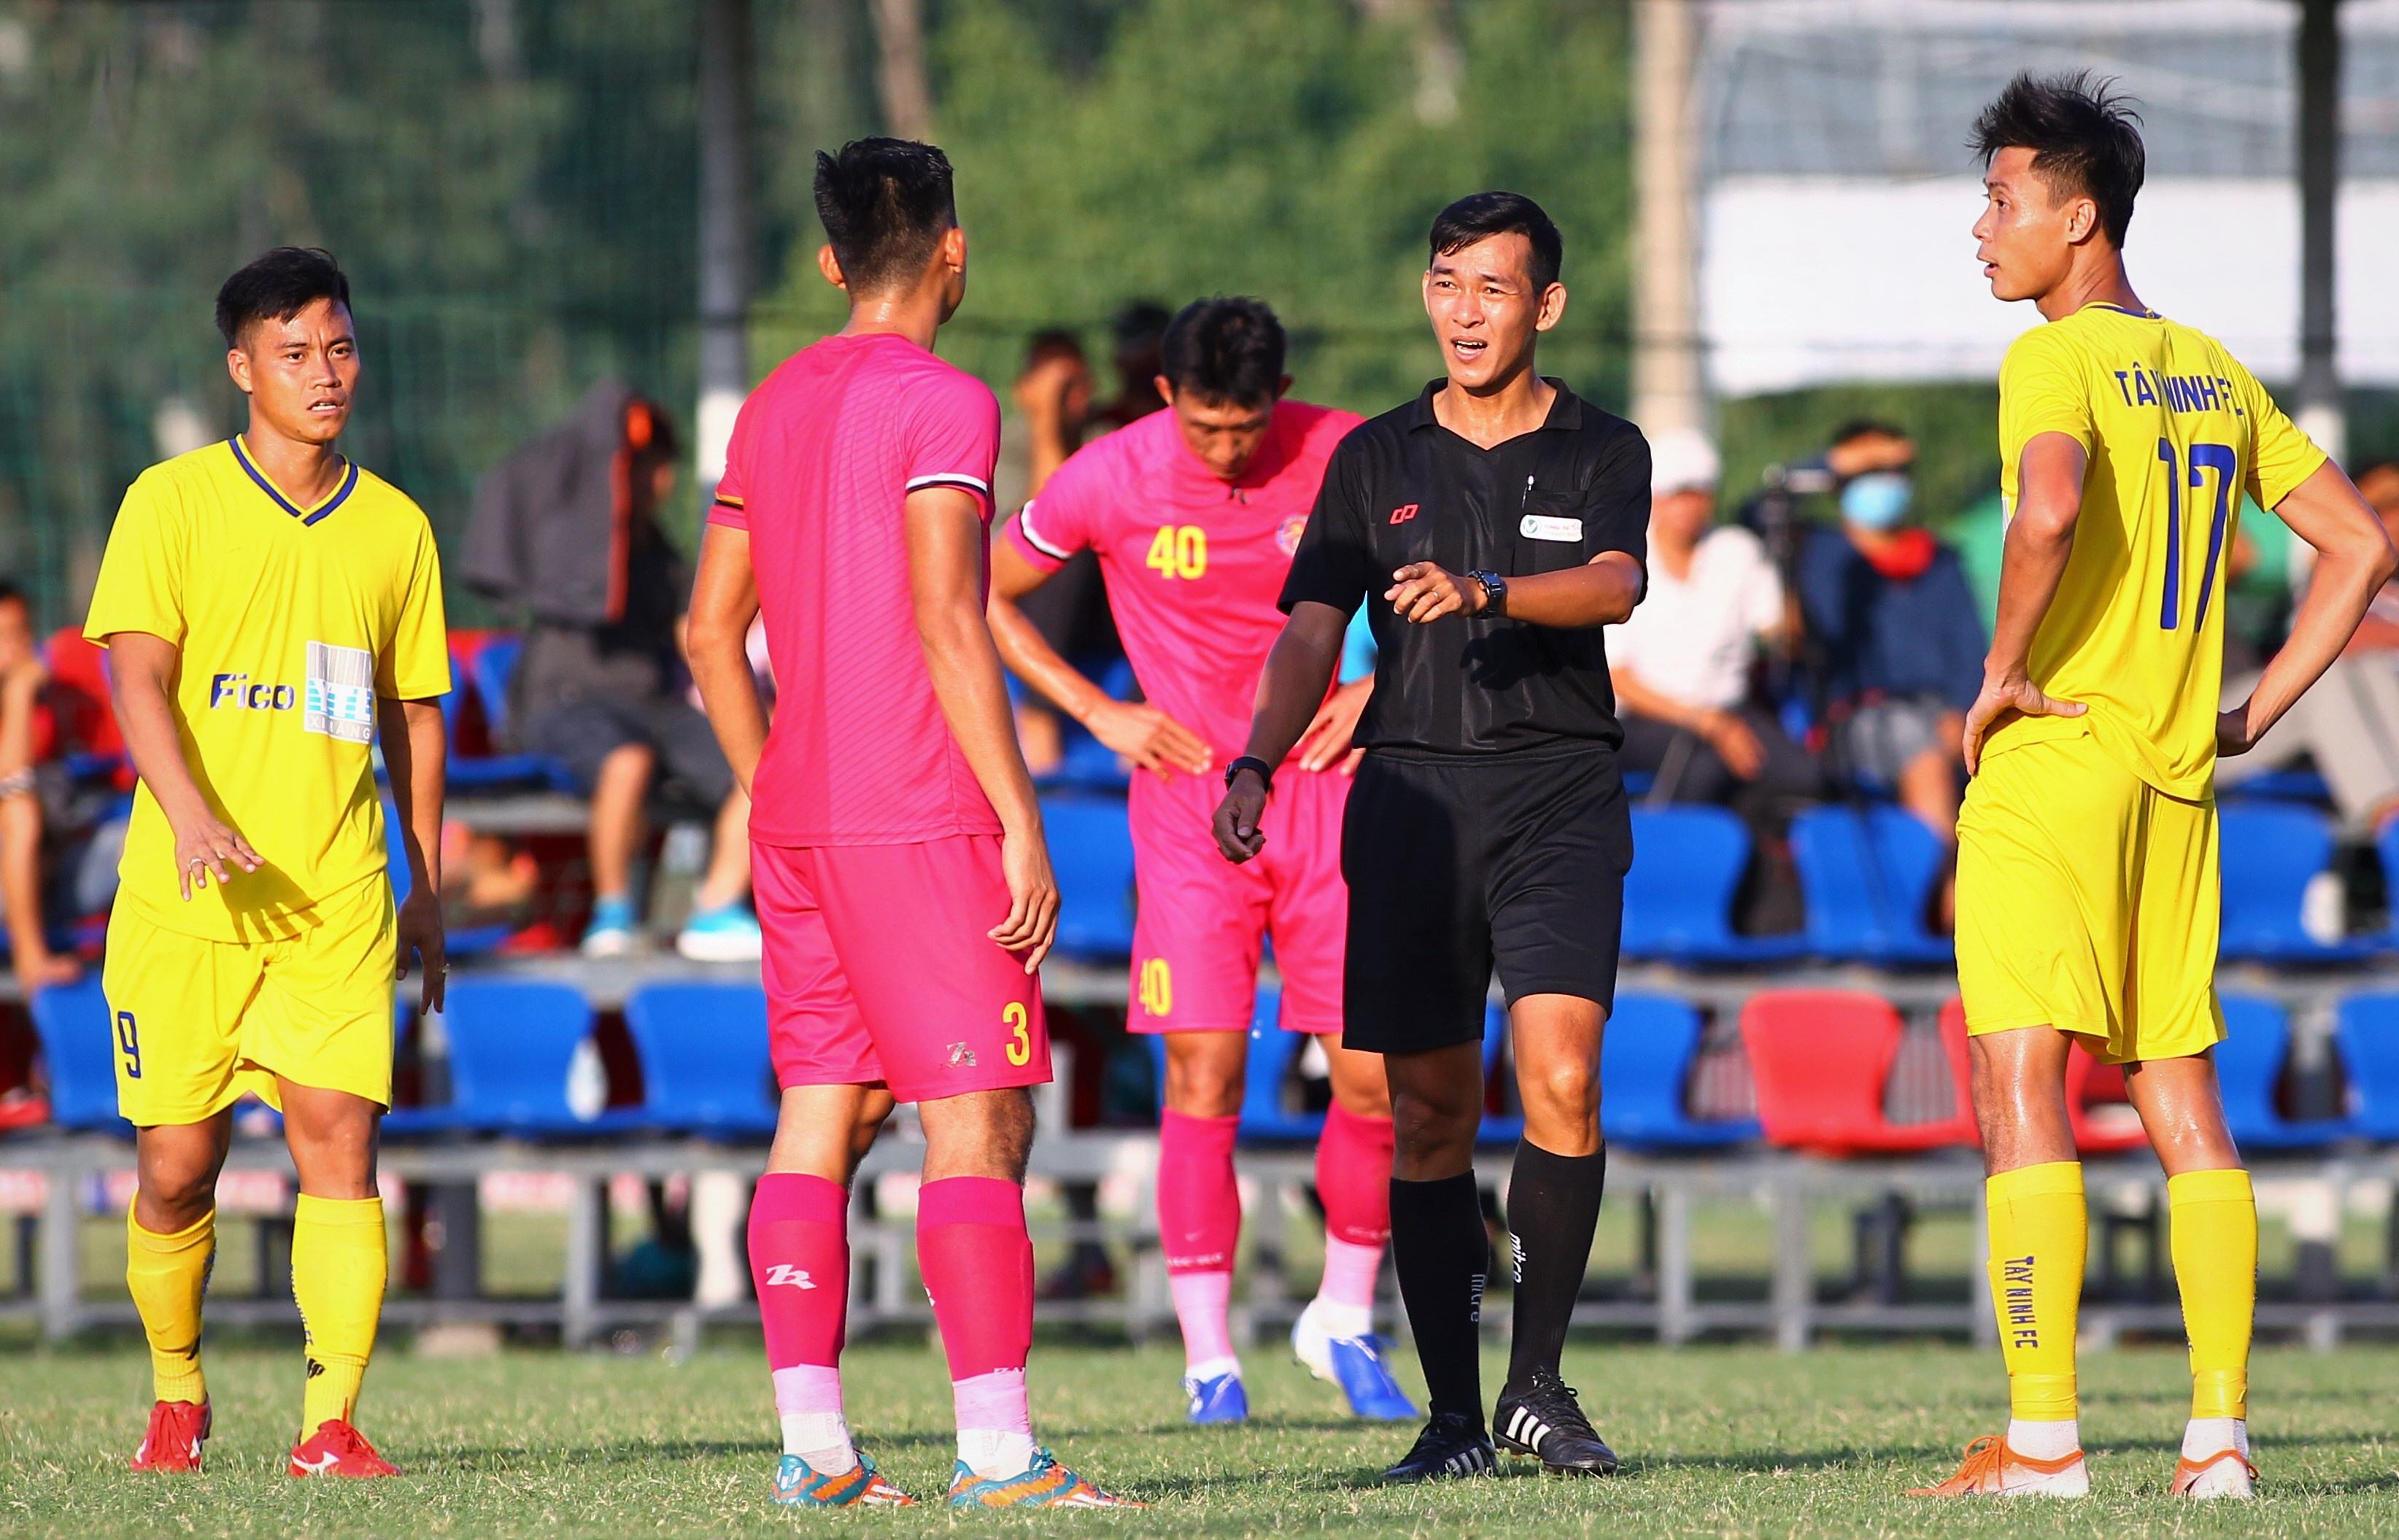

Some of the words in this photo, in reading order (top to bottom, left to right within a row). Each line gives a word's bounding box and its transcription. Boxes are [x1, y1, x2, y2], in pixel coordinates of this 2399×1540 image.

[2217, 377, 2244, 416] F
[1145, 525, 1208, 580] 40
[2157, 437, 2236, 633] 17
[209, 673, 295, 711] Fico
[1138, 956, 1173, 1018] 40
[117, 1010, 142, 1079] 9
[1001, 1001, 1031, 1067] 3
[1507, 1230, 1527, 1284] mitre
[2004, 1255, 2034, 1284] TAY
[2005, 1288, 2036, 1324] NINH
[2012, 1329, 2039, 1349] FC
